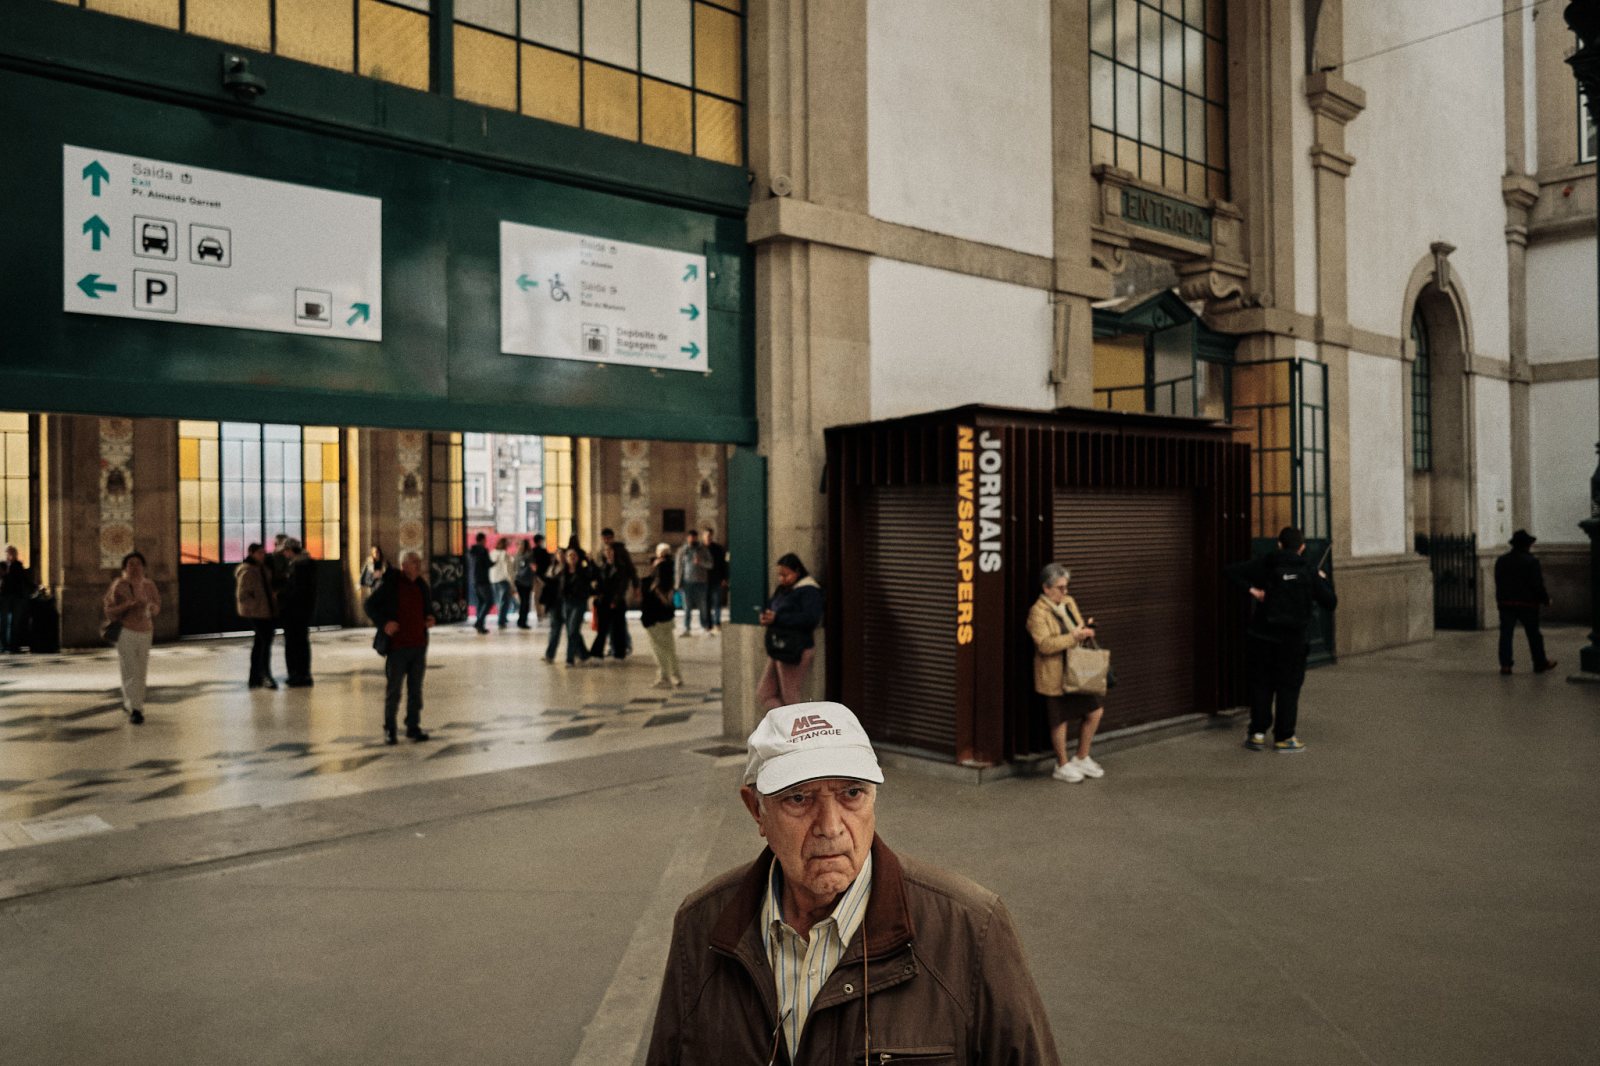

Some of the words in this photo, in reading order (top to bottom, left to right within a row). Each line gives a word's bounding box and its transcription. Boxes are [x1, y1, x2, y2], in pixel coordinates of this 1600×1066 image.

[1125, 190, 1205, 238] ENTRADA
[146, 278, 168, 304] P
[956, 424, 975, 646] NEWSPAPERS
[978, 430, 1002, 573] JORNAIS
